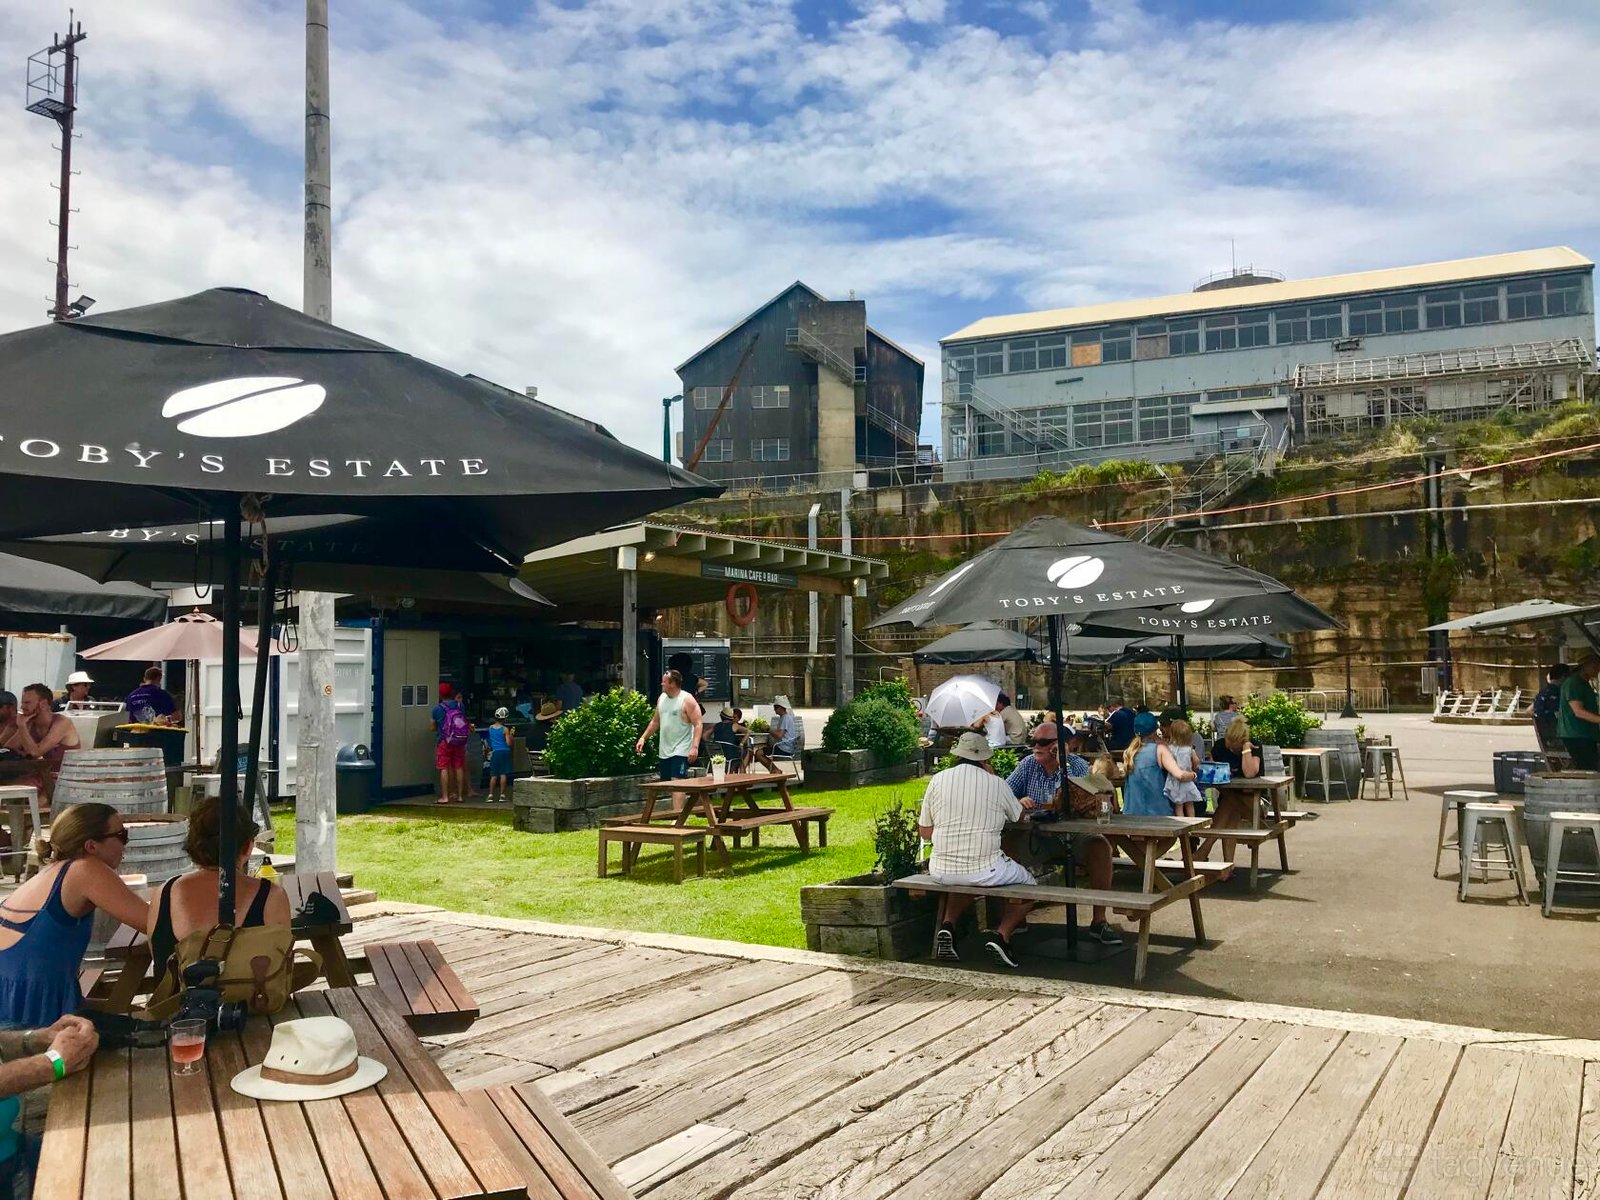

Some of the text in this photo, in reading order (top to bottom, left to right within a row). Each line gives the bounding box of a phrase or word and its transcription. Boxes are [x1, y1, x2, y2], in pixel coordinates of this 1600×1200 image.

[0, 435, 489, 477] OBY'S ESTATE
[82, 528, 373, 553] BY'S STATE
[724, 567, 748, 579] MARINA
[748, 570, 762, 581] CAFE
[767, 573, 778, 583] BAR
[1000, 585, 1185, 608] TOBY'S ESTATE
[1138, 615, 1273, 629] TOBY'S ESTATE
